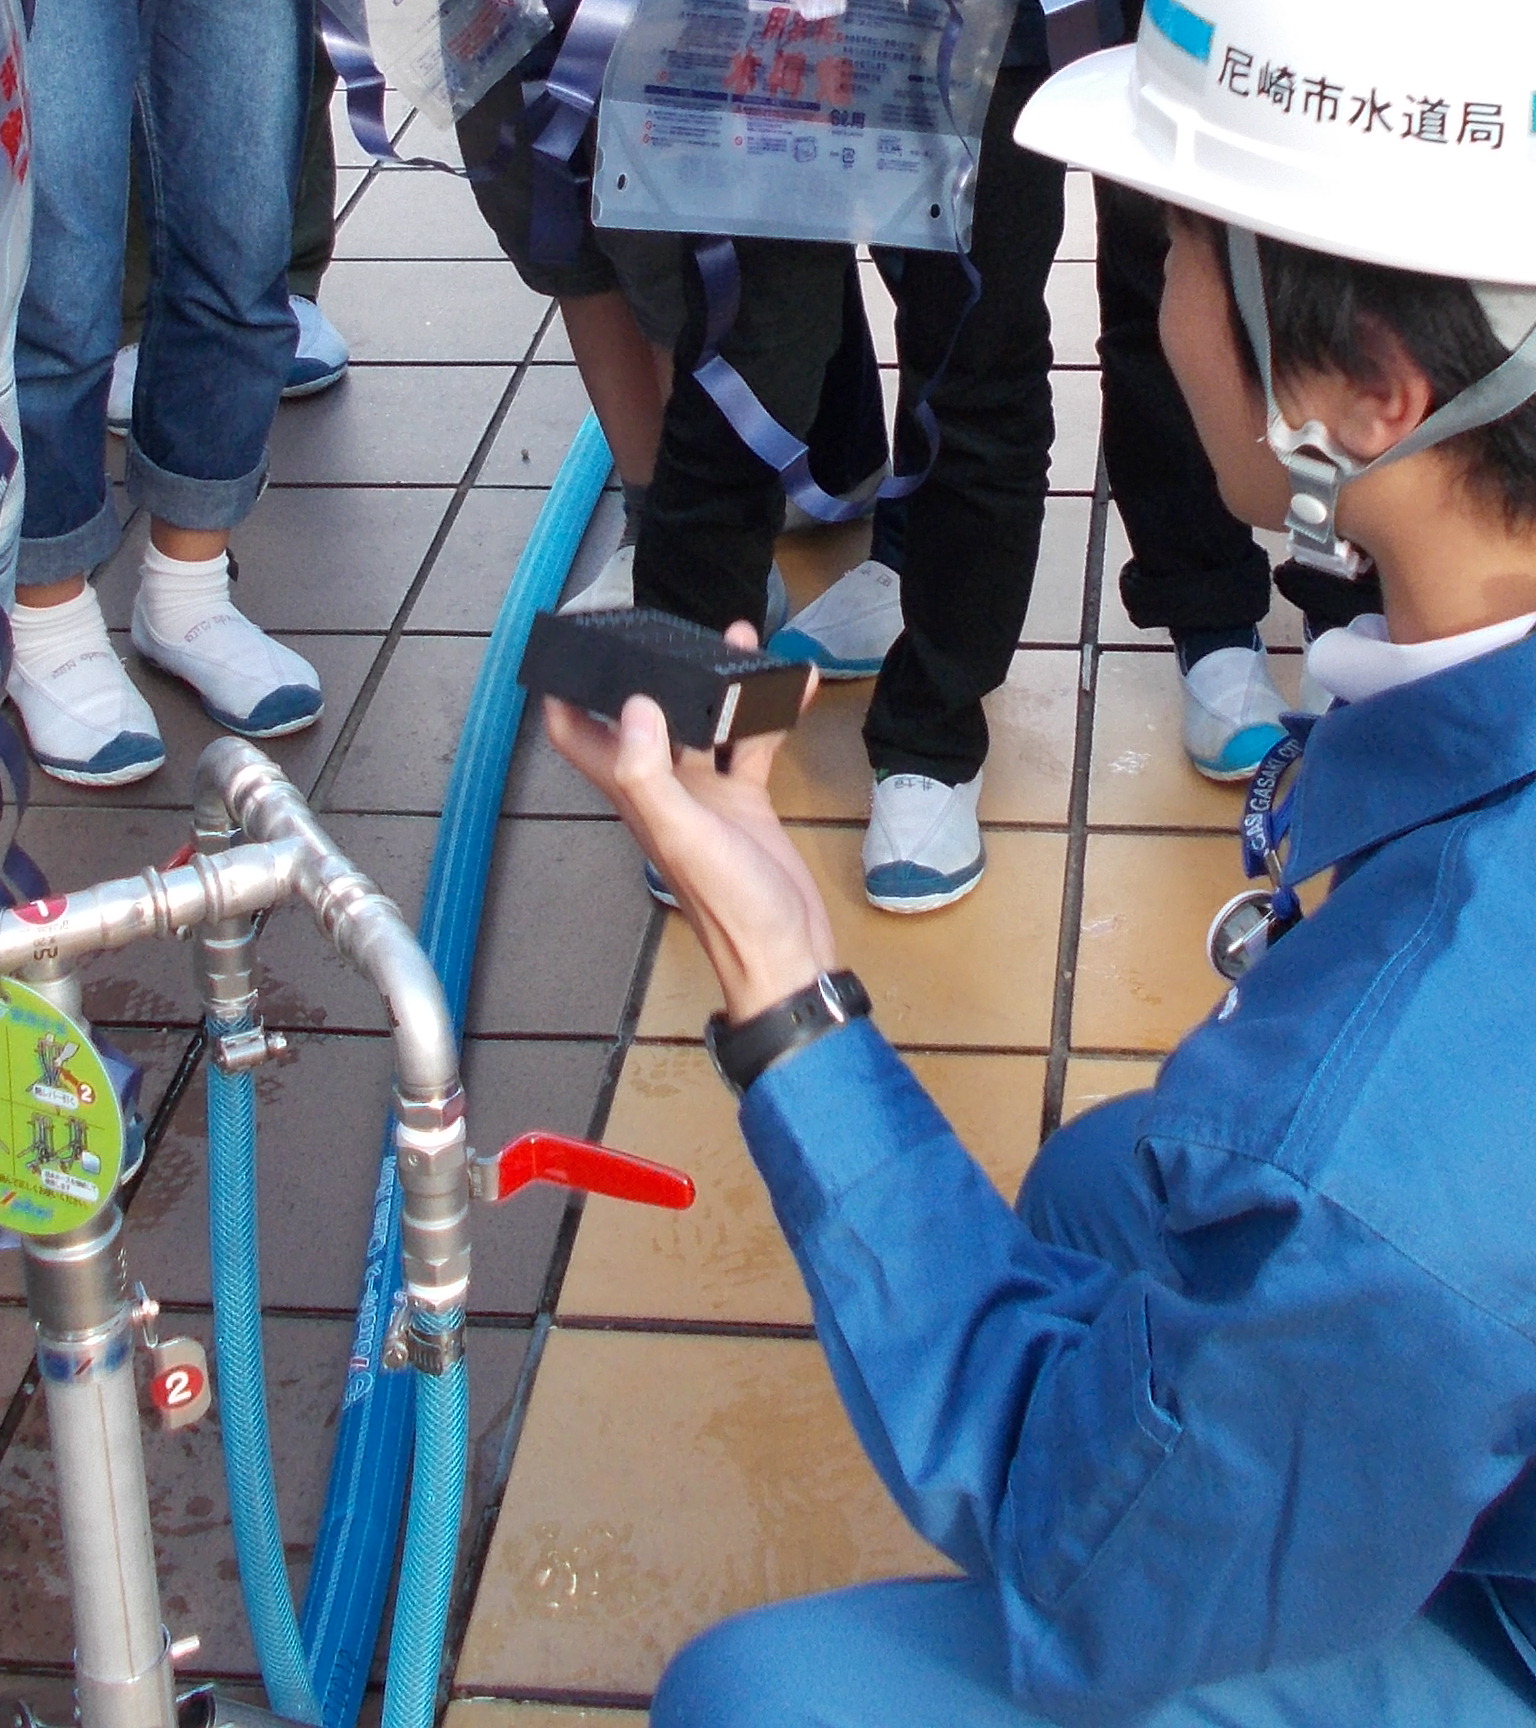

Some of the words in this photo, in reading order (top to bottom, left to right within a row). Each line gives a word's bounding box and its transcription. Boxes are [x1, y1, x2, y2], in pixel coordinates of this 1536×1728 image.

[1217, 45, 1506, 151] 尼崎市水道局
[165, 1370, 193, 1404] 2
